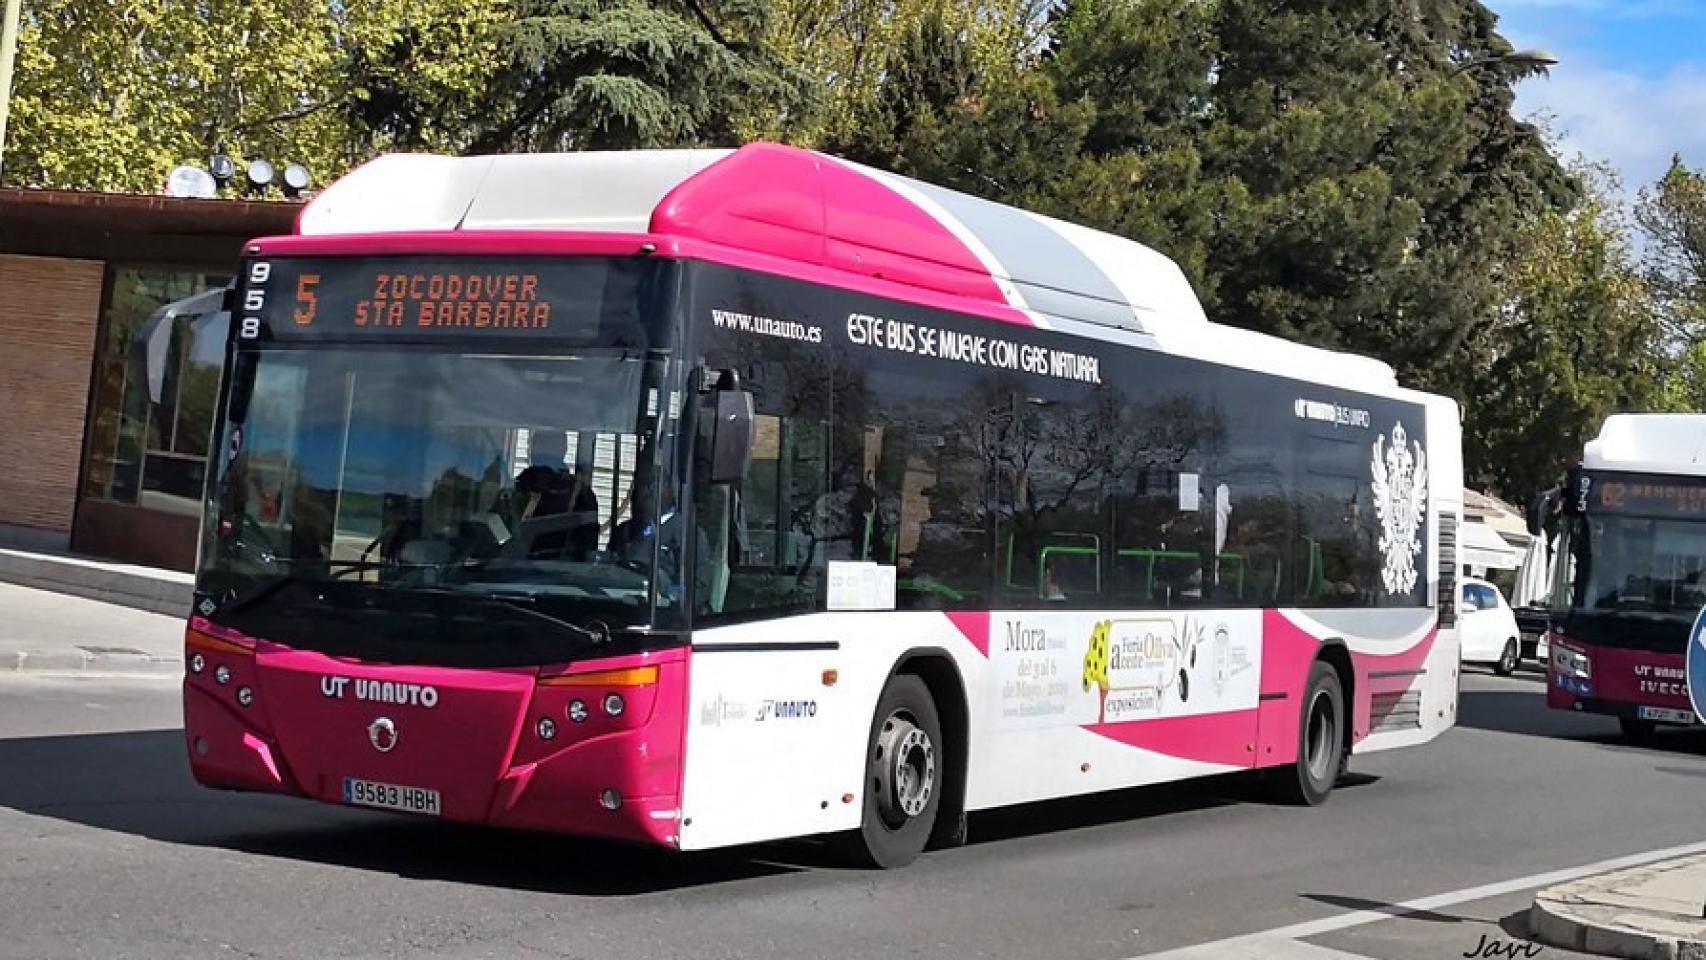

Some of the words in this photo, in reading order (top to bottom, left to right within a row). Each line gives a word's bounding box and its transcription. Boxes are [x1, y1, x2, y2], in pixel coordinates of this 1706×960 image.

[240, 261, 271, 340] 958
[293, 275, 320, 325] 5
[374, 274, 539, 301] ZOCODOVER
[354, 301, 404, 326] STA
[418, 301, 551, 328] BARBARA
[712, 309, 823, 344] www.unauto.es
[847, 313, 884, 347] ESTE
[886, 319, 916, 353] BUS
[918, 326, 937, 357] SE
[939, 330, 987, 365] MUEVE
[989, 339, 1018, 370] CON
[1021, 344, 1048, 376] GAS
[1050, 350, 1101, 384] NATURAL
[1004, 620, 1046, 651] Mora
[355, 679, 438, 708] UNAUTO
[774, 699, 818, 719] UNAUTO
[354, 781, 399, 806] 9583
[402, 785, 437, 812] HBH
